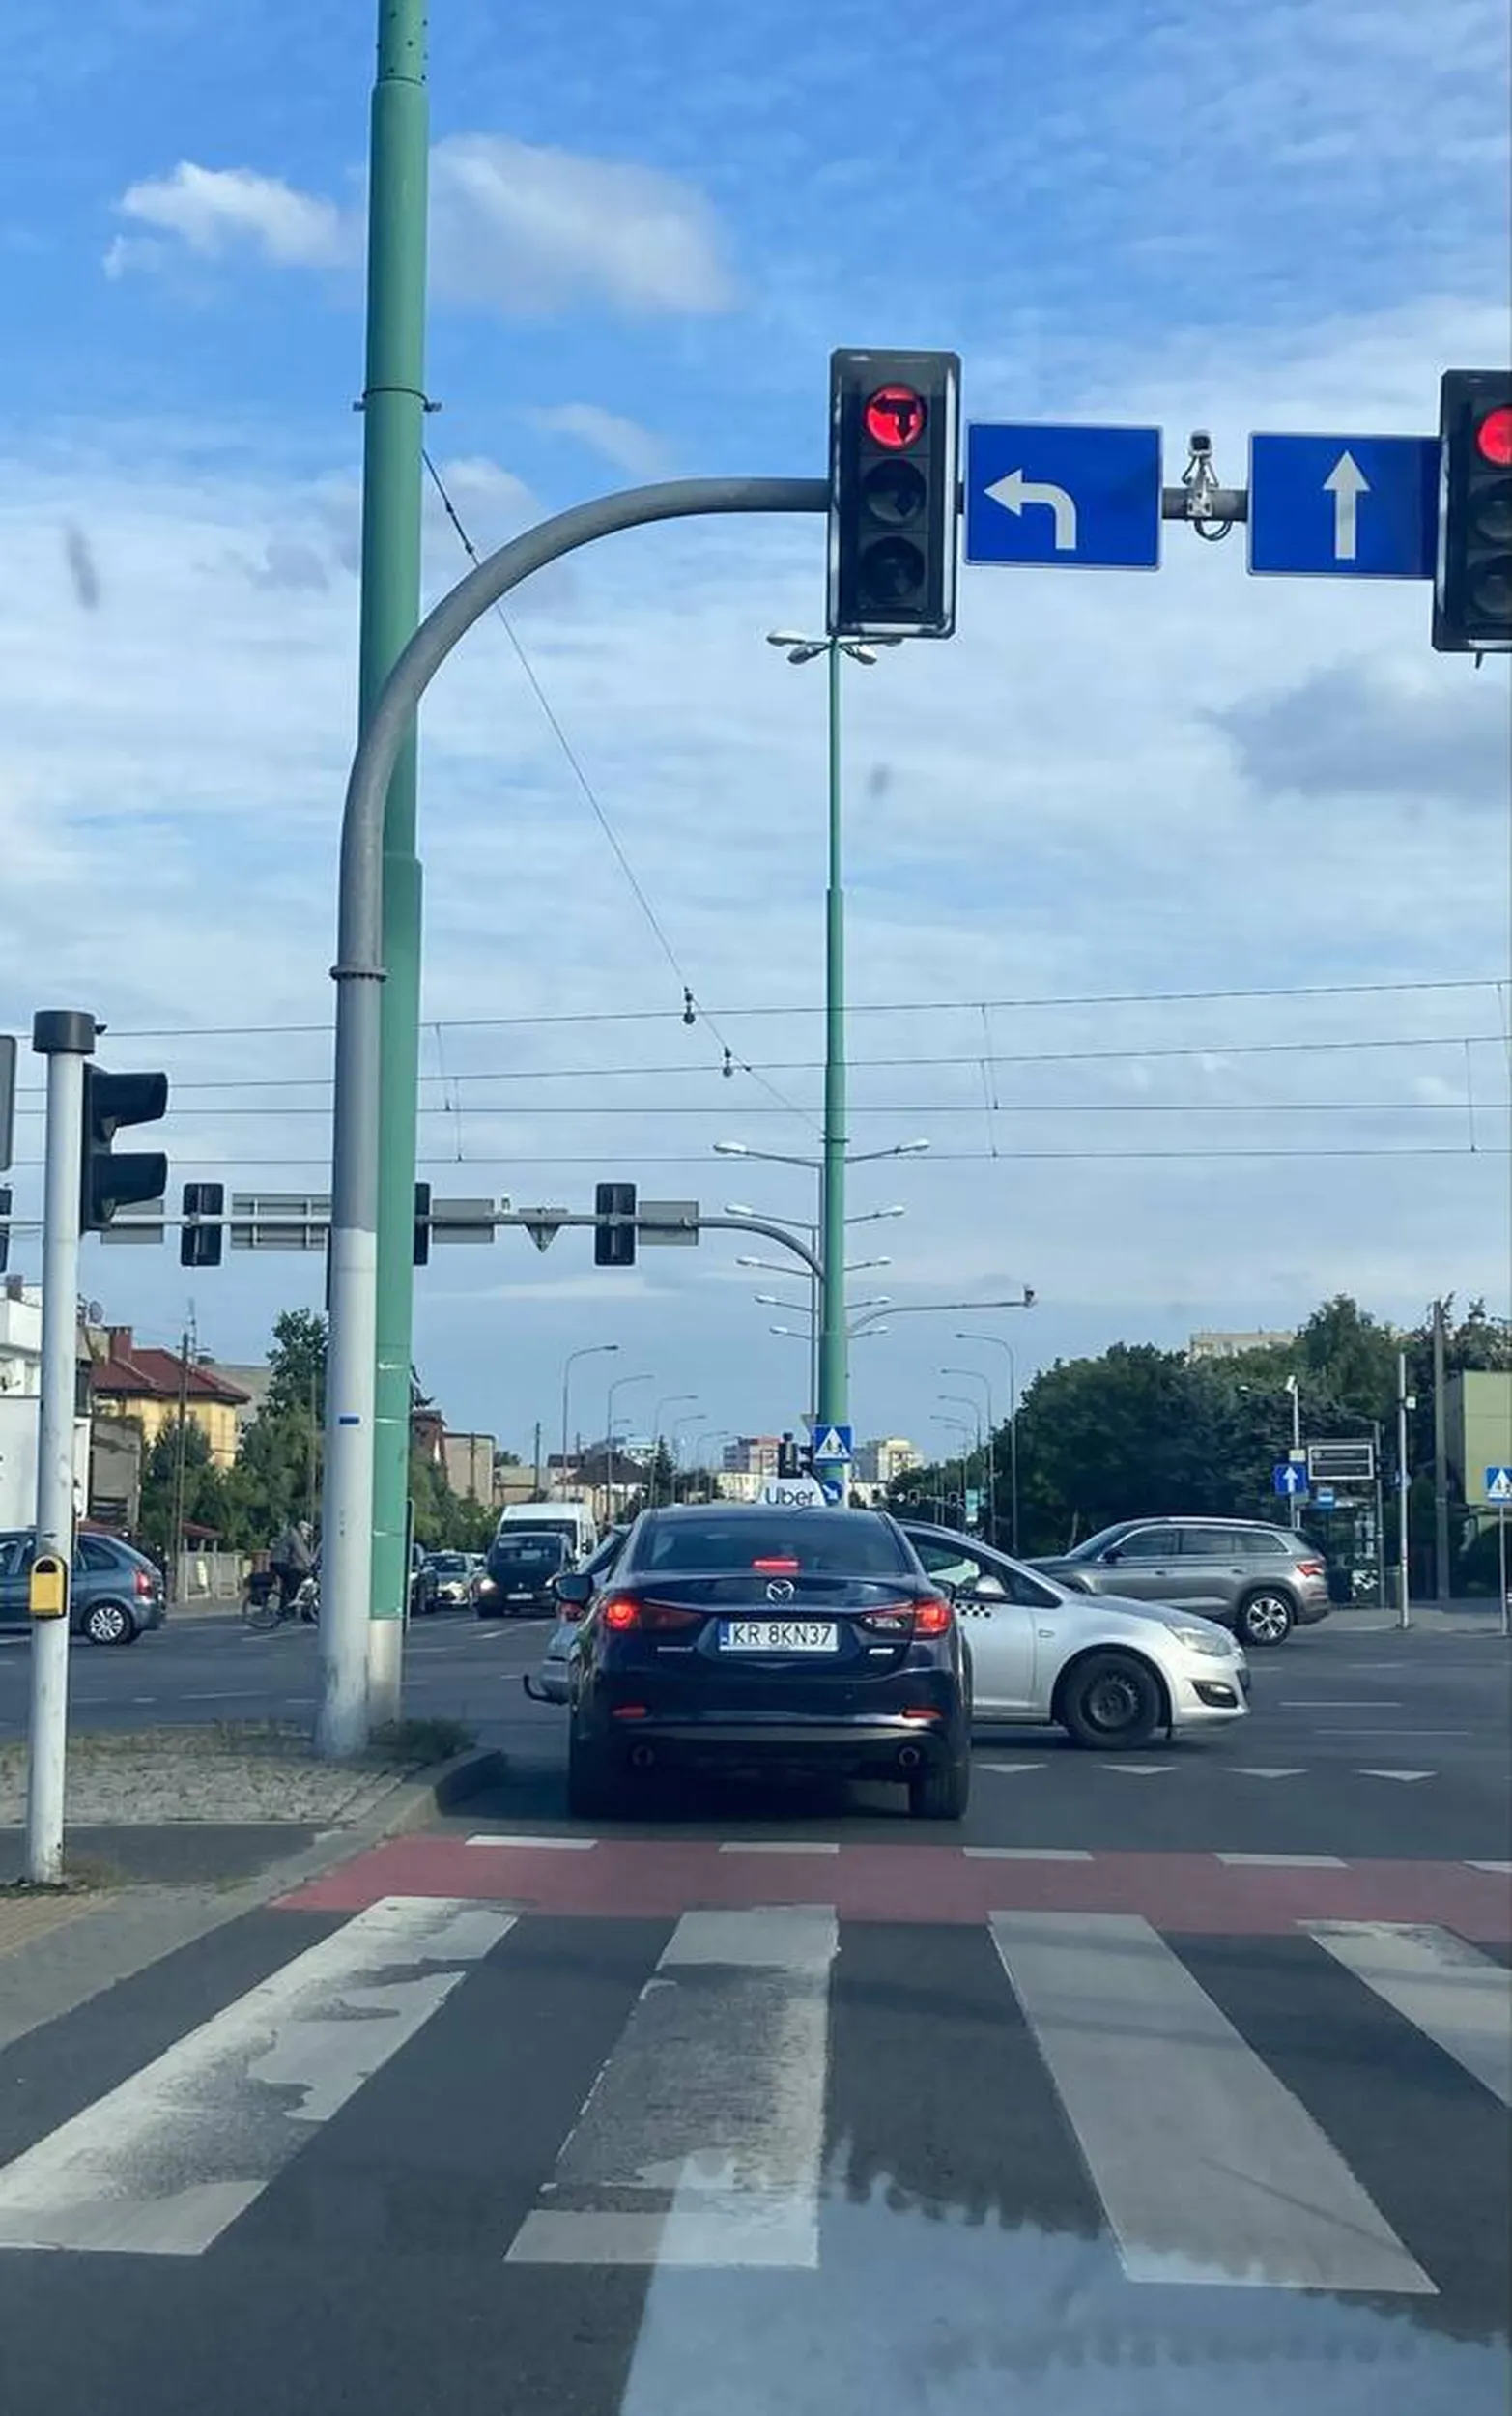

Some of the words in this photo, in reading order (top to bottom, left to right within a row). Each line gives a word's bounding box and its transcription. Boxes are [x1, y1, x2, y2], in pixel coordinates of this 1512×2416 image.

[765, 1487, 814, 1506] Uber
[734, 1625, 760, 1644] KR
[769, 1625, 831, 1645] 8KN37
